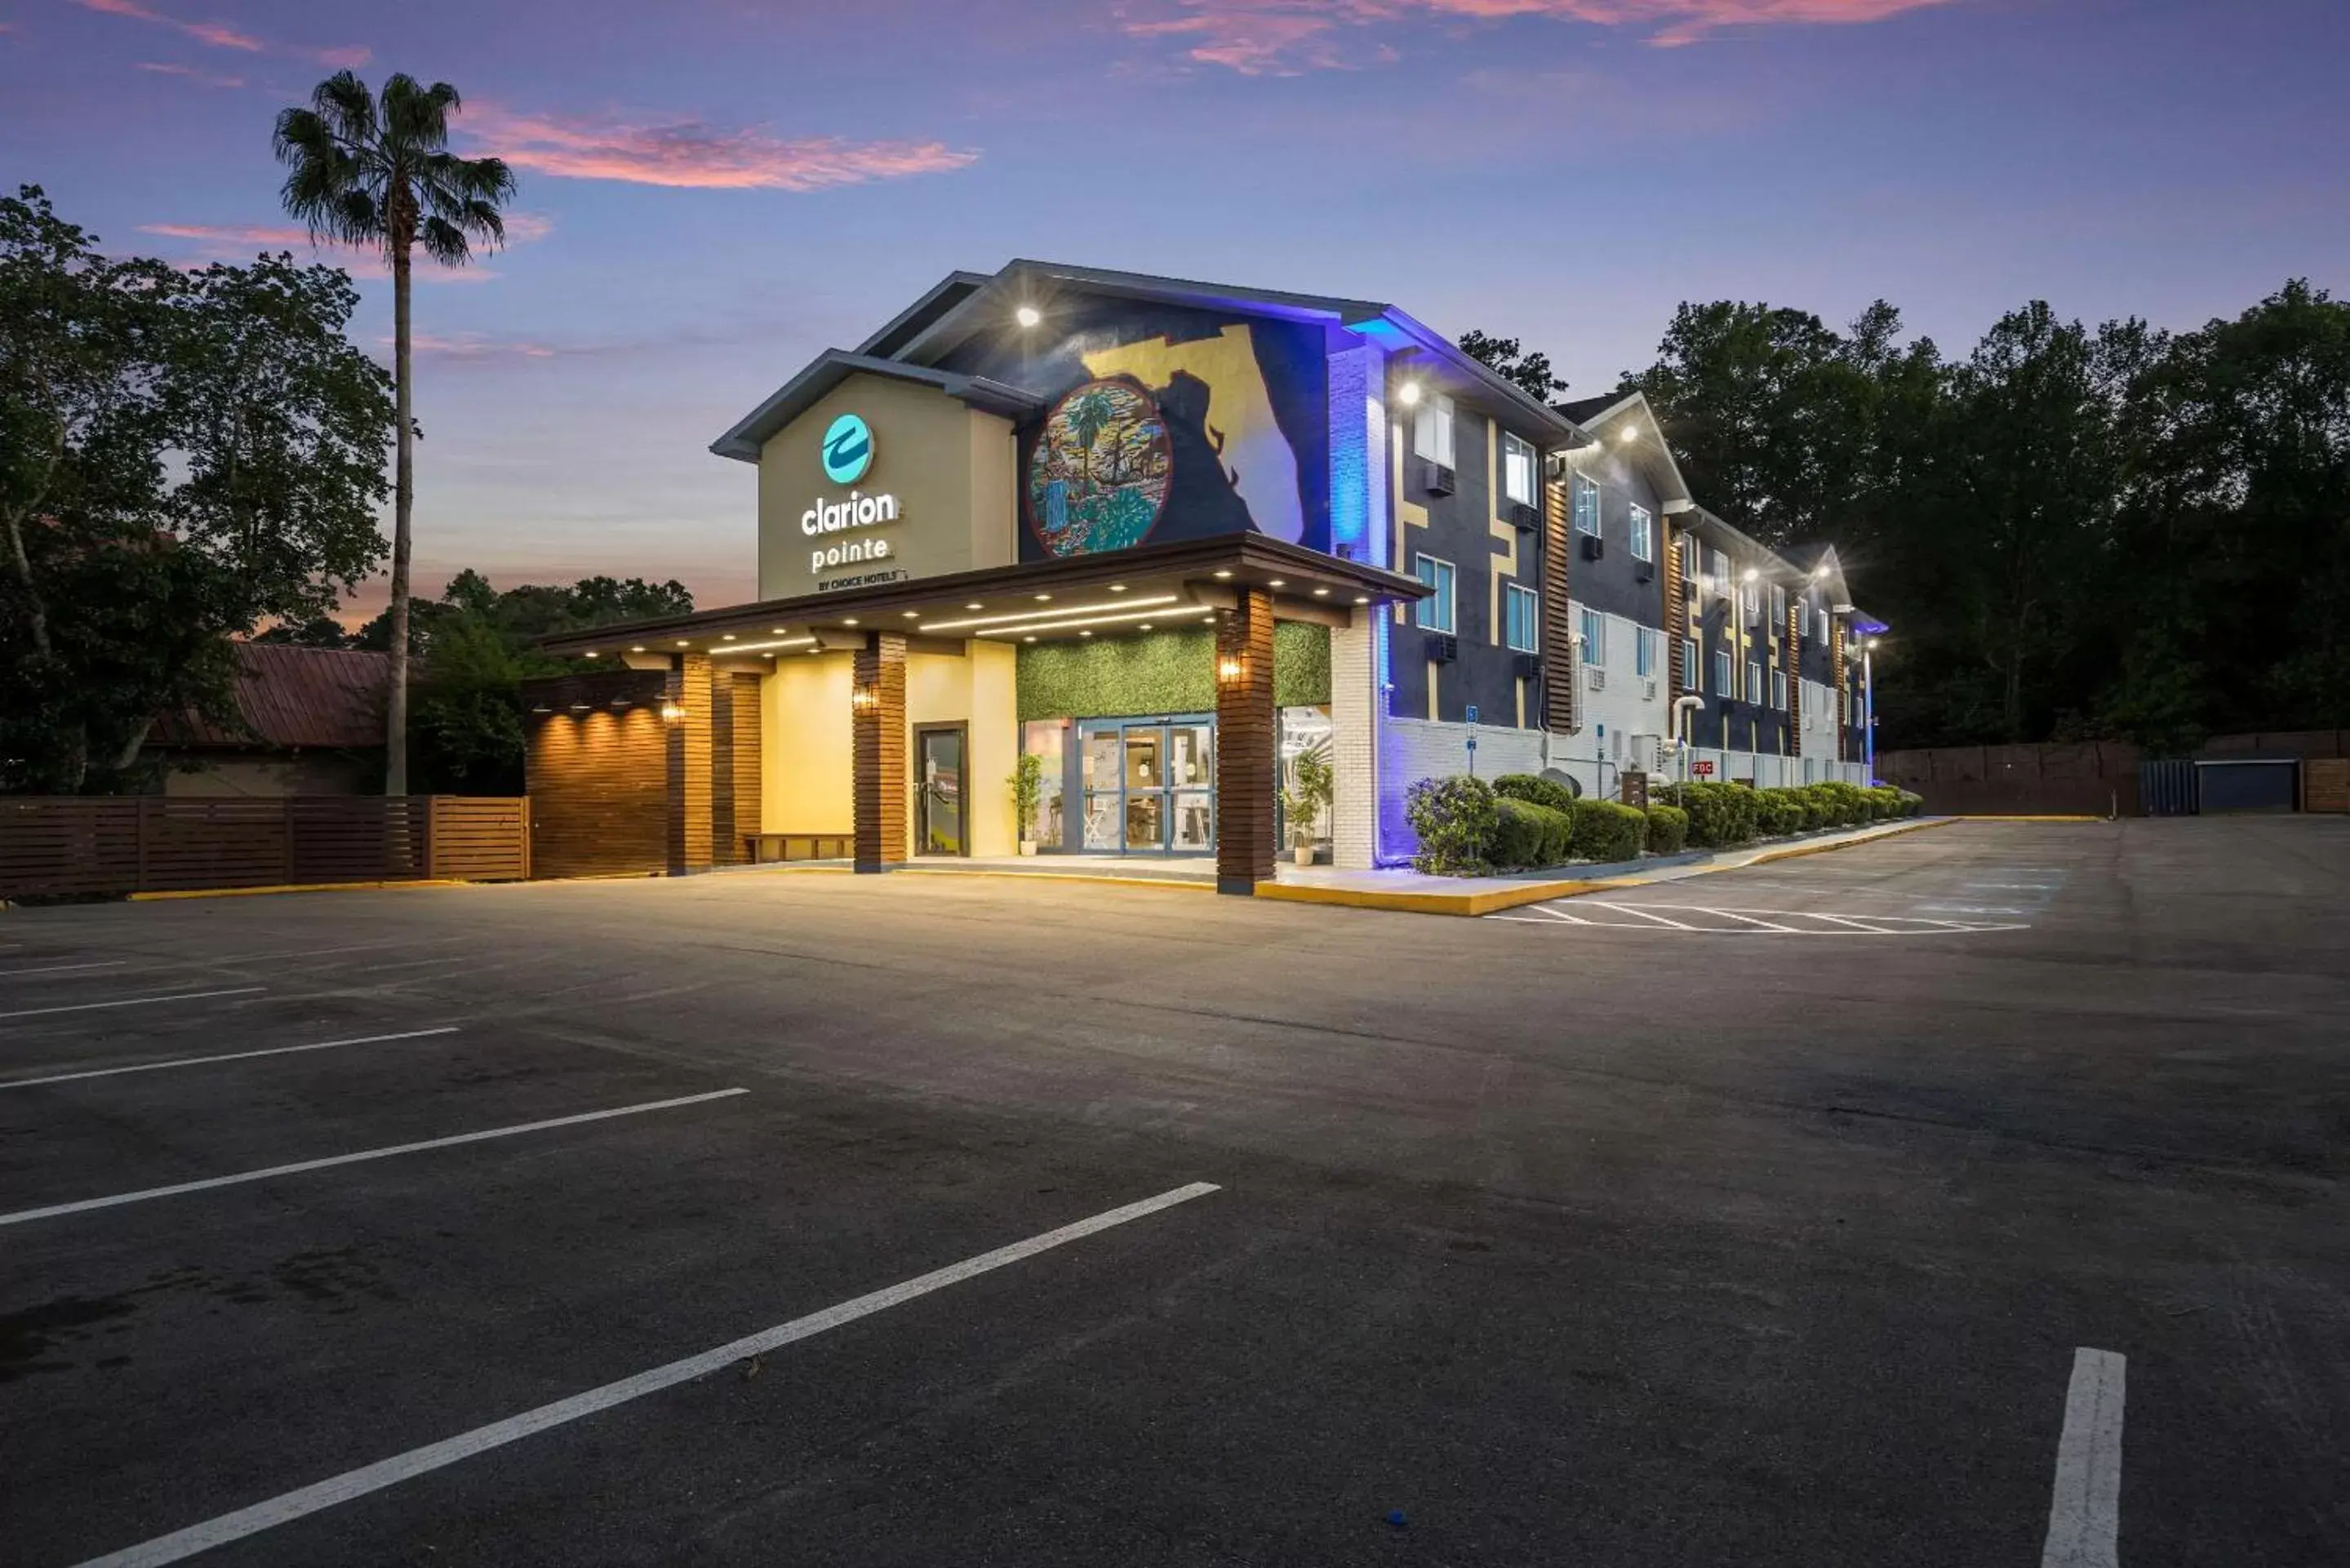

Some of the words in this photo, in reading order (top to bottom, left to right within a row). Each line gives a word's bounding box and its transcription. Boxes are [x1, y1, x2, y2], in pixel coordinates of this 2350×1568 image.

[802, 491, 894, 535] clarion
[812, 538, 887, 574] pointe
[819, 580, 829, 591] BY
[831, 575, 863, 589] CHOICE
[864, 572, 896, 584] HOTELS
